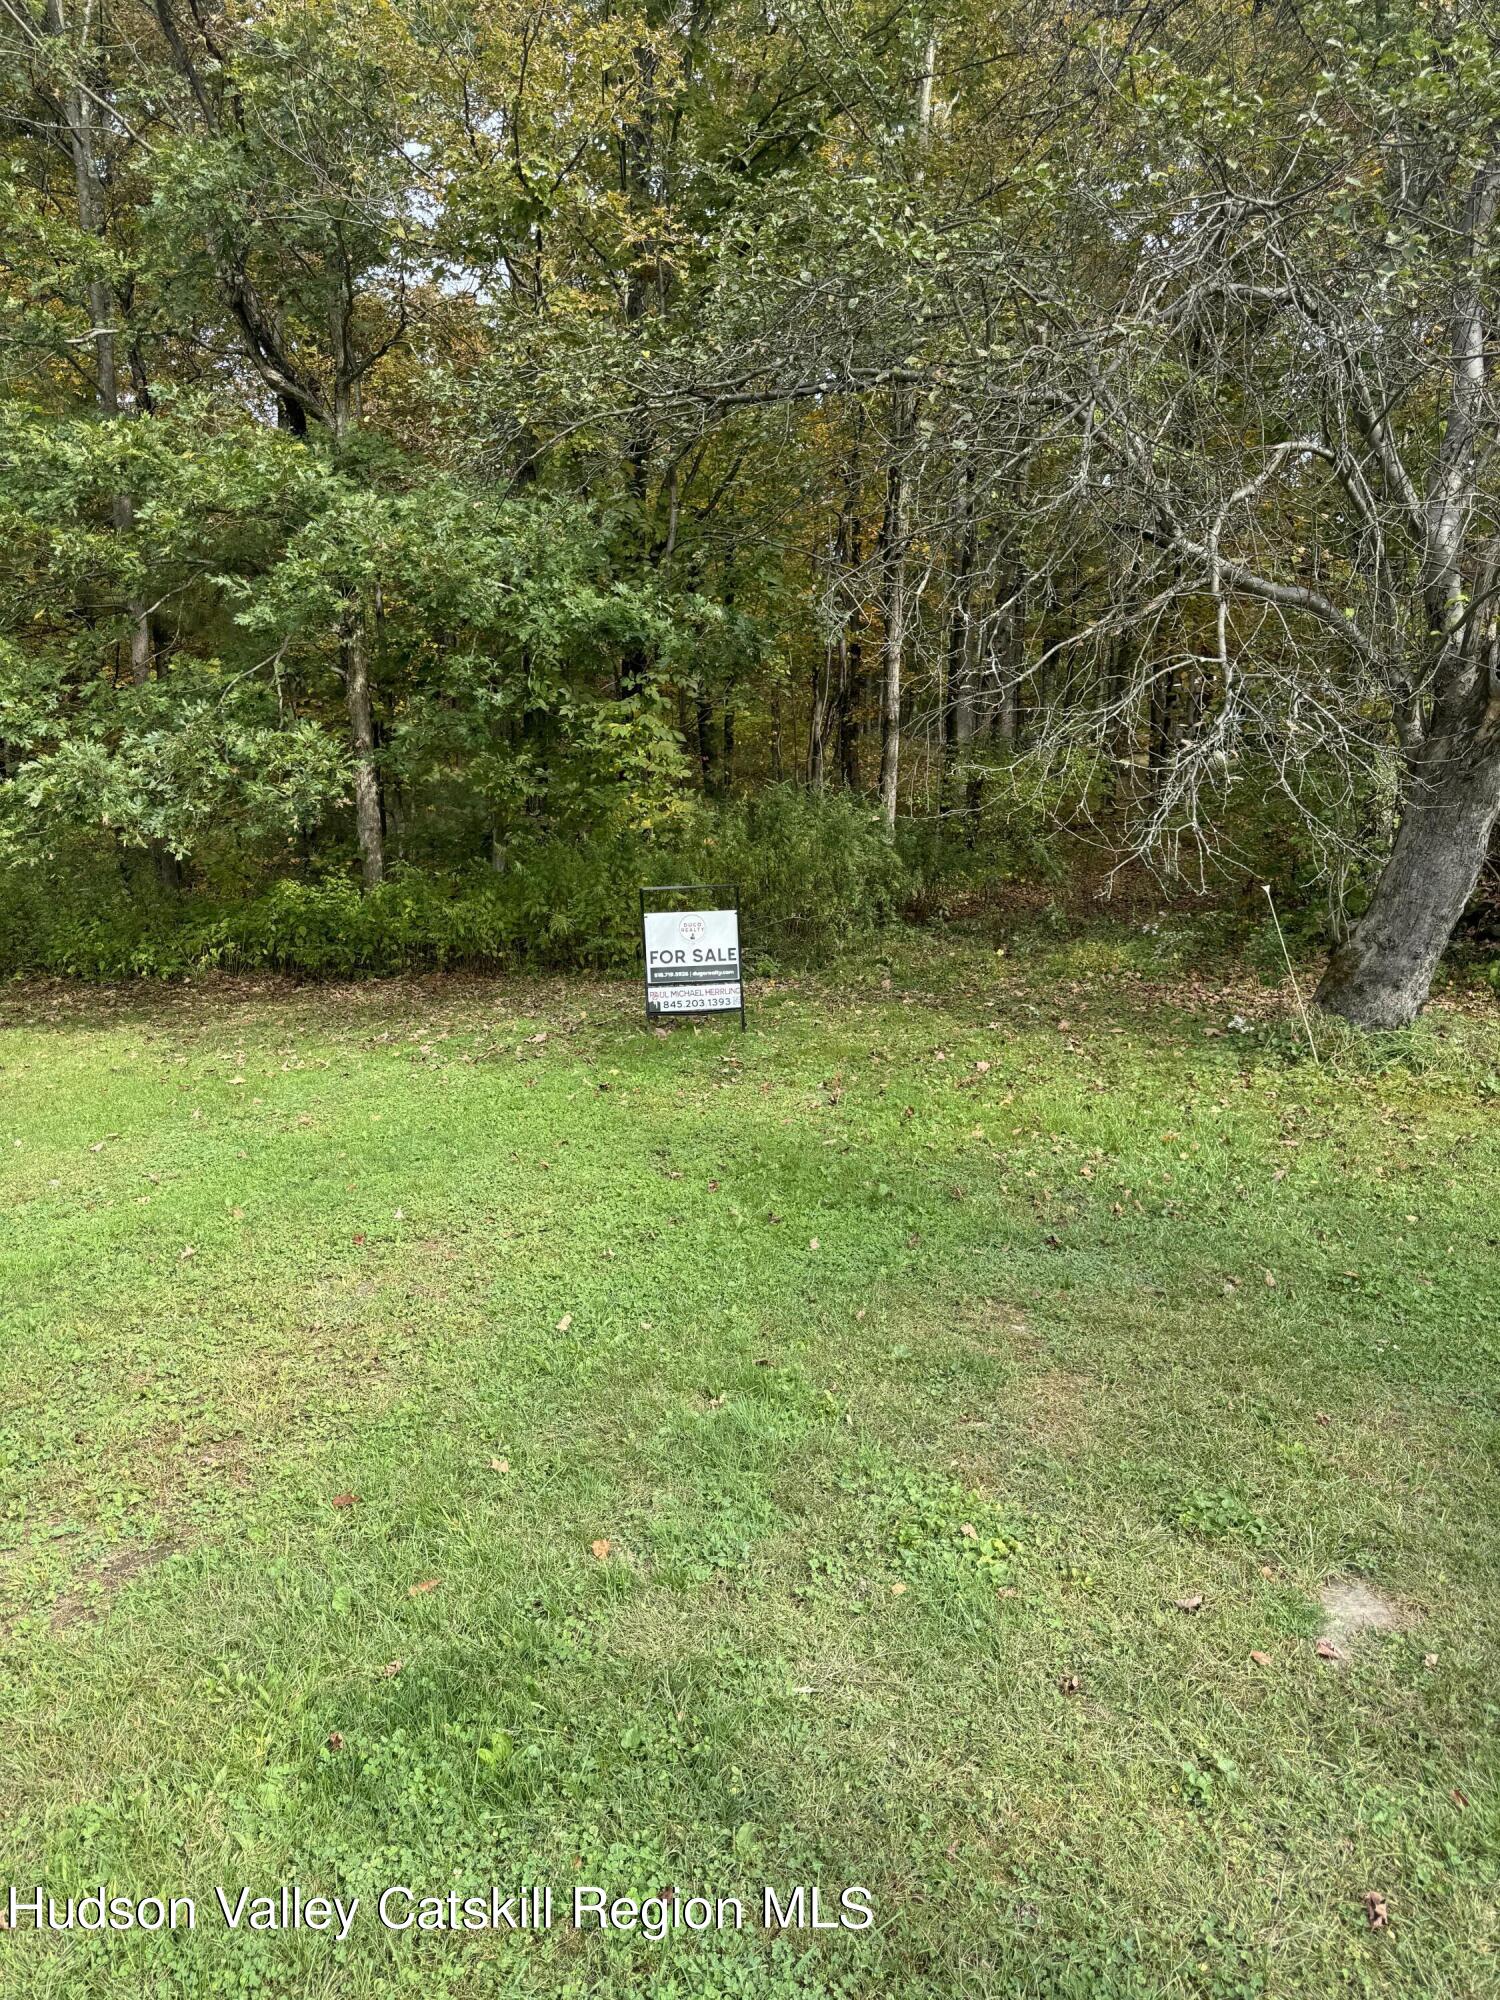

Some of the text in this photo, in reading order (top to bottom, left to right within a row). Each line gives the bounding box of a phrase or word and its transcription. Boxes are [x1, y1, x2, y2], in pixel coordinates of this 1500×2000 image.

[650, 948, 737, 964] FOR SALE
[649, 991, 669, 999] PAUL
[671, 989, 704, 998] MICHAEL
[663, 998, 732, 1009] 845.203.1393
